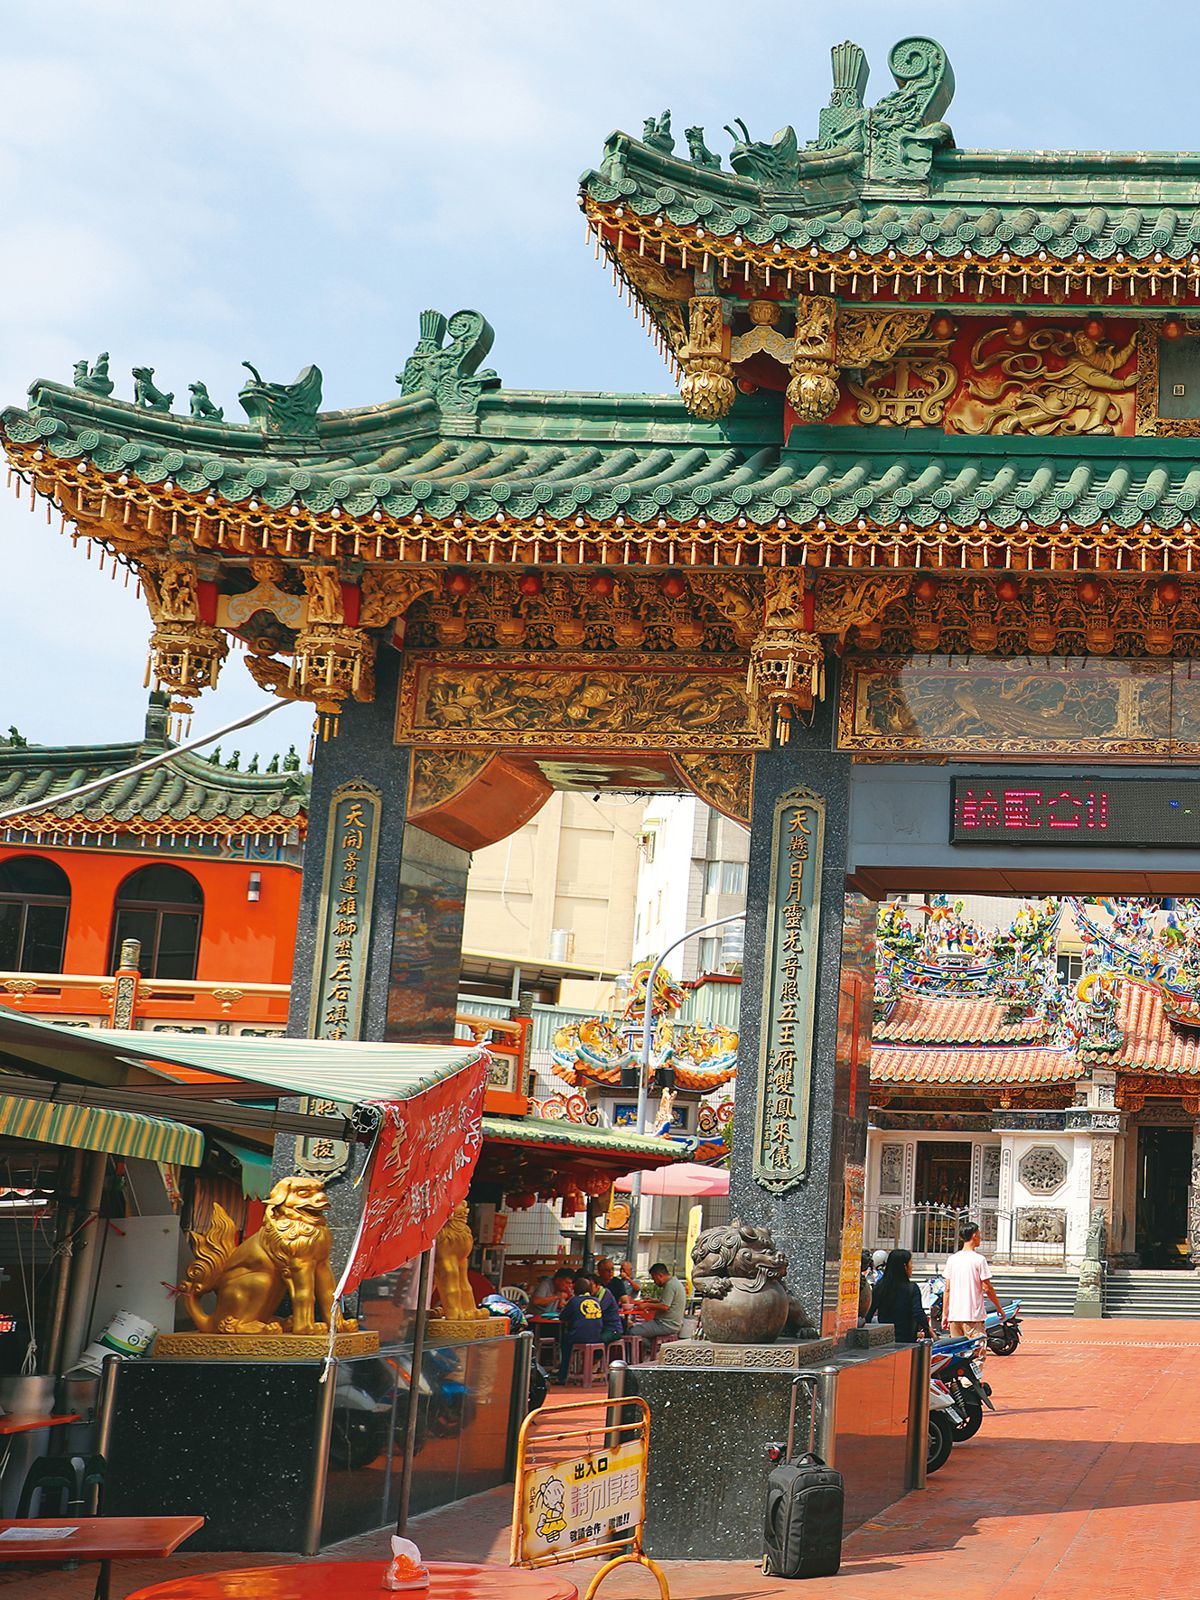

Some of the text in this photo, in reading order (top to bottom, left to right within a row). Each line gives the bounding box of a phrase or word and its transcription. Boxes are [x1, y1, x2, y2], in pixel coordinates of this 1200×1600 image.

[574, 1457, 608, 1480] 出入口
[570, 1470, 640, 1523] 請勿停車
